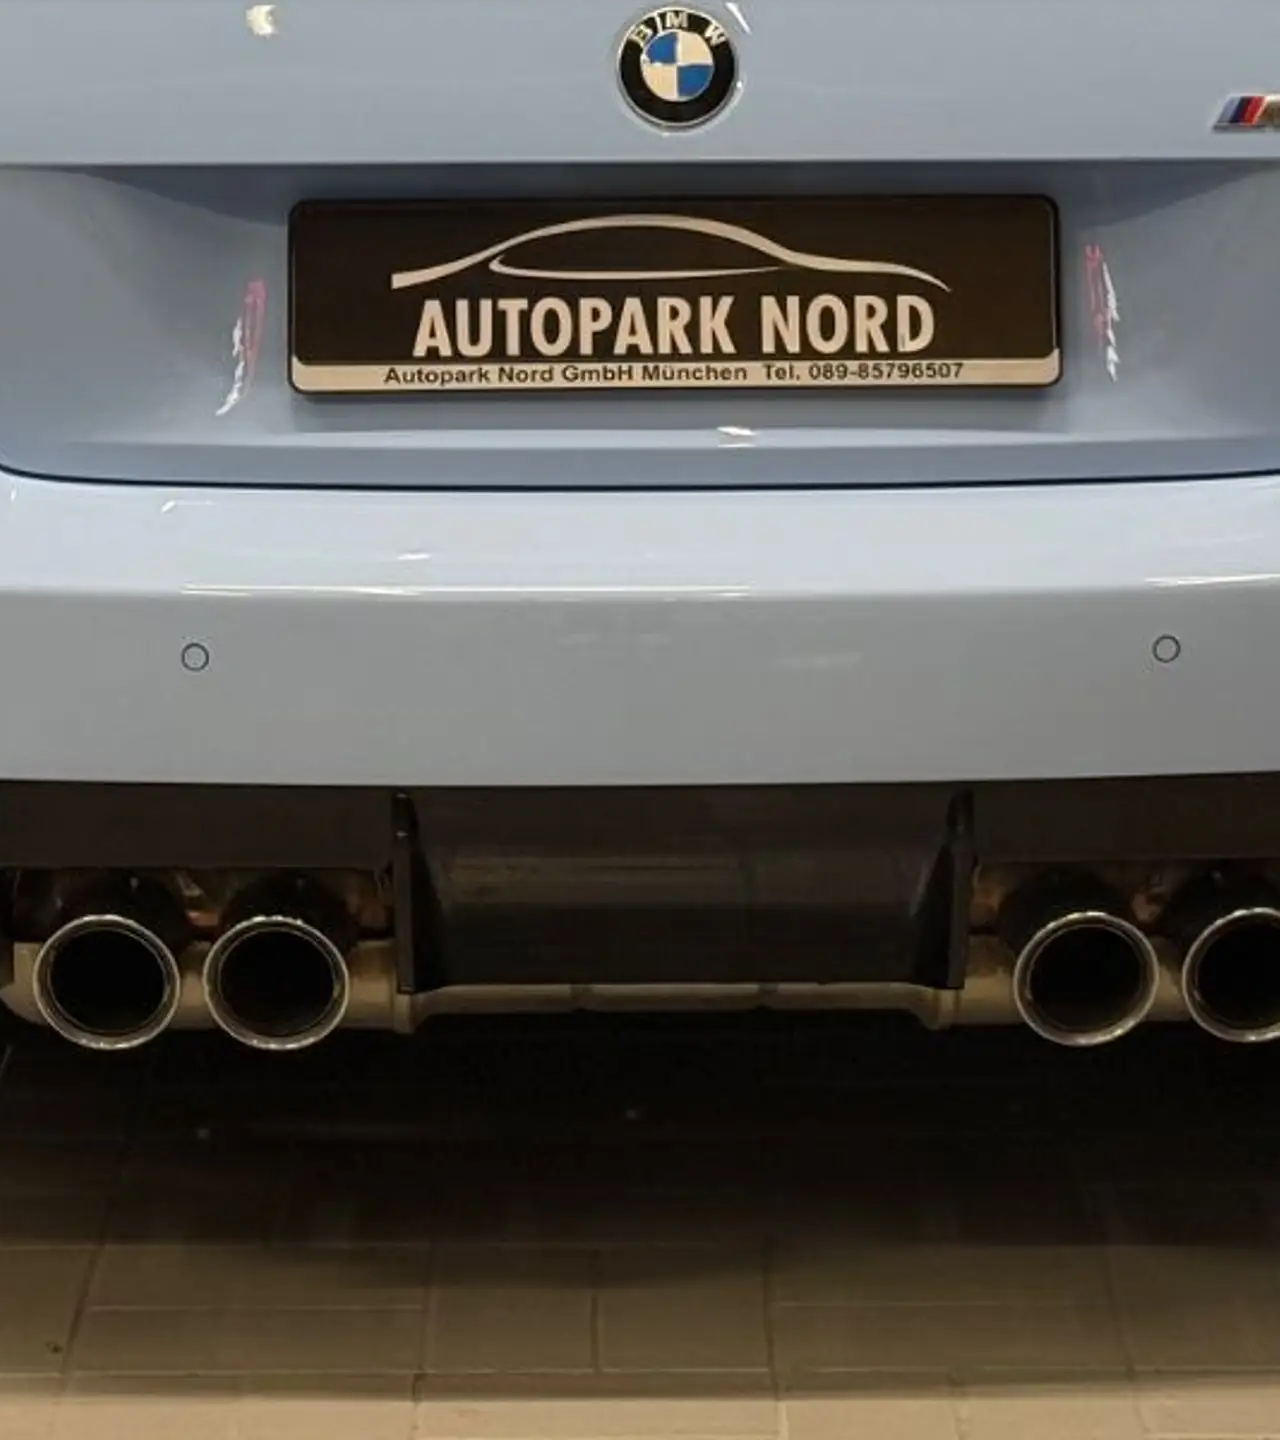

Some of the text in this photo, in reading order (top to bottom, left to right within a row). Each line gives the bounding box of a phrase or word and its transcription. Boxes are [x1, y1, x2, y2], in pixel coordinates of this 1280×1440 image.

[629, 11, 727, 47] BMW
[412, 294, 935, 357] AUTOPARK NORD
[384, 361, 965, 386] Autopark Nord GmbH München Tel. 089-85796507
